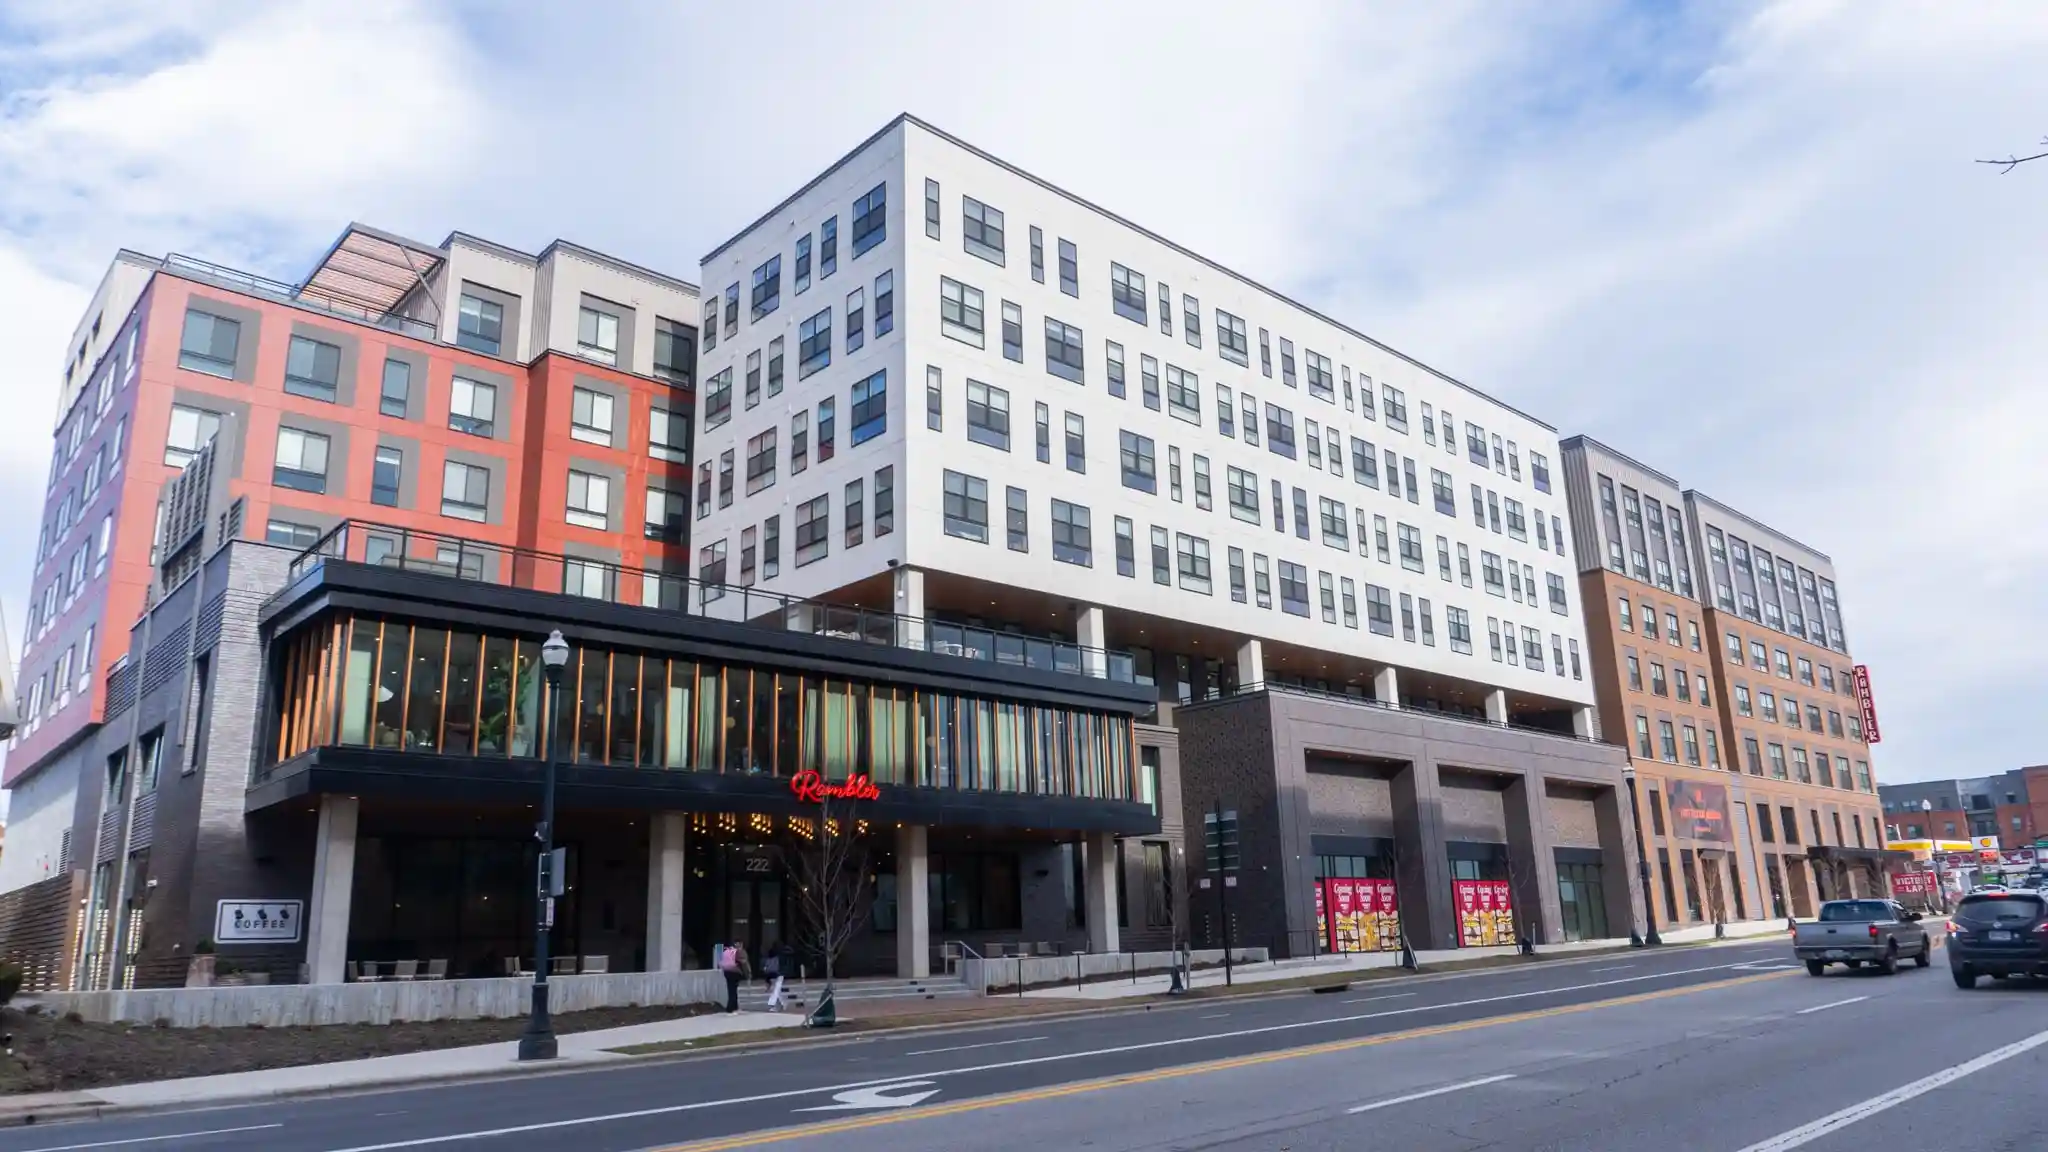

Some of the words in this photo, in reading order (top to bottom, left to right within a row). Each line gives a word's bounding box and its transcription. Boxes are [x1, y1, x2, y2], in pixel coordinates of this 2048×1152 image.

[1856, 667, 1878, 741] RAMBLER
[790, 769, 881, 803] Rambler
[746, 858, 770, 871] 222
[234, 919, 286, 929] COFFEE
